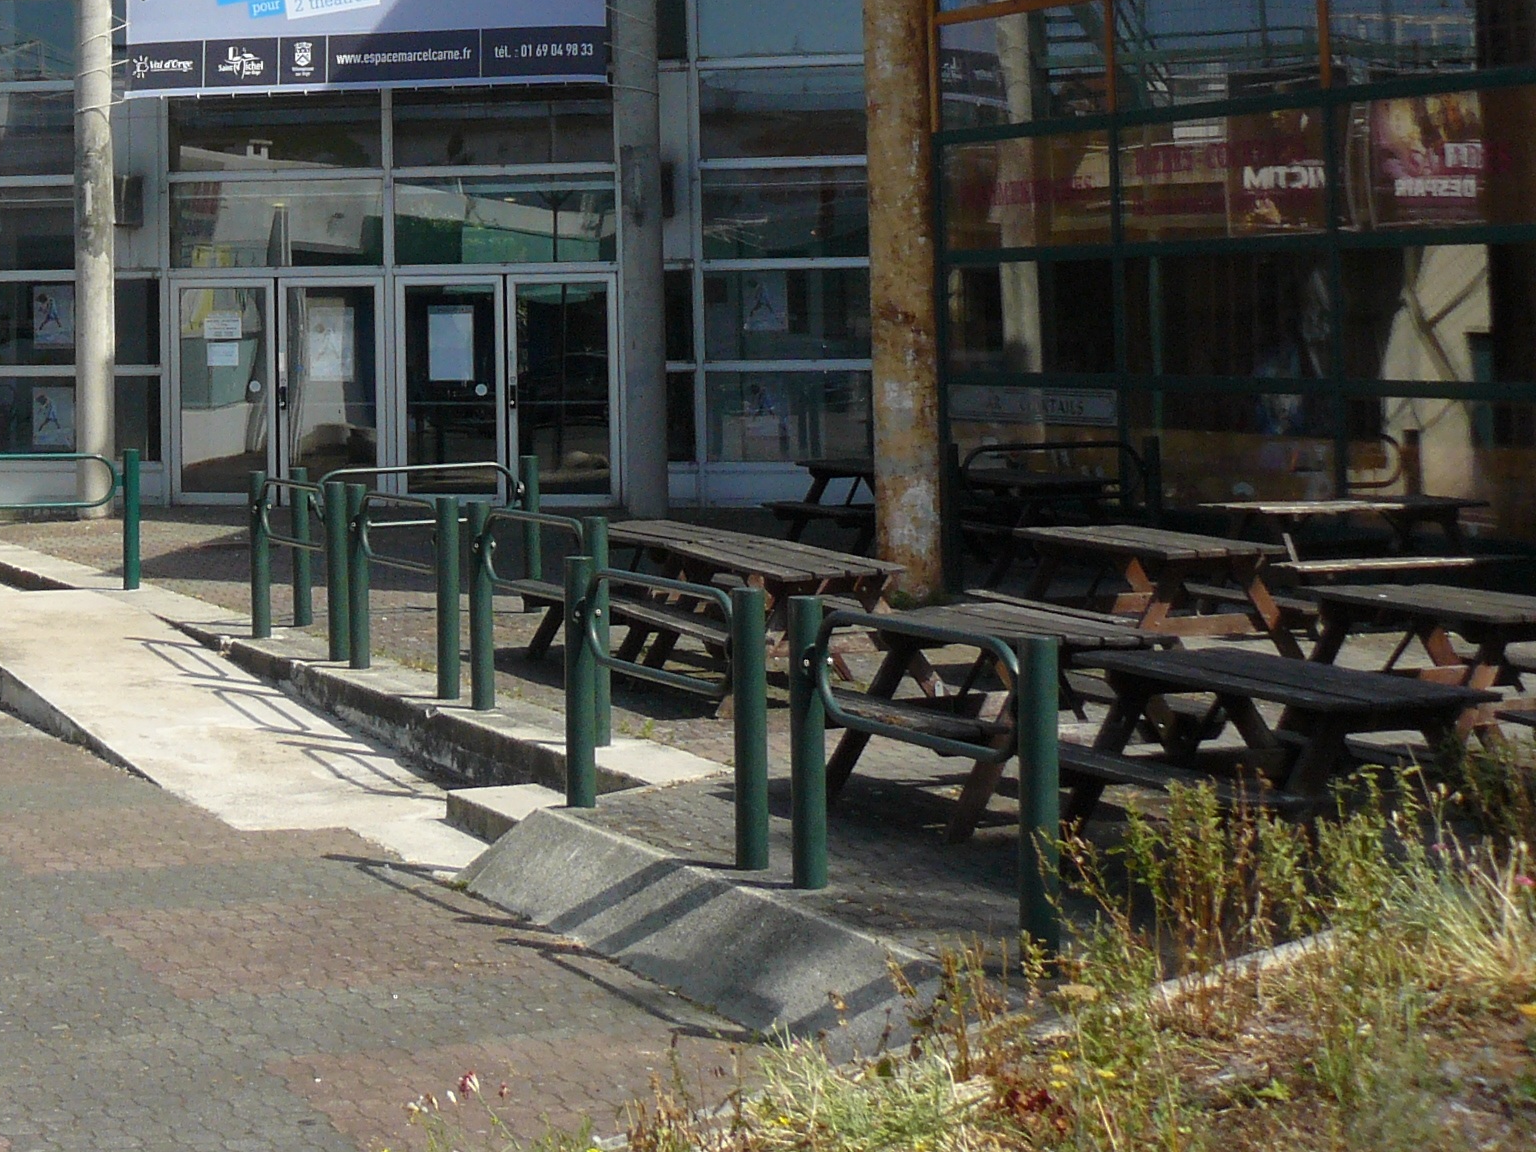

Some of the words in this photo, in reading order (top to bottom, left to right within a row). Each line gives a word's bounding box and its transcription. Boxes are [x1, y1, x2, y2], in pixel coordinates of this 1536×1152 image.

[252, 0, 281, 16] pour
[335, 47, 472, 66] www.espacemarcelcarne.fr
[493, 44, 512, 59] tél.
[520, 43, 533, 58] 01
[535, 43, 549, 57] 69
[550, 43, 564, 57] 04
[565, 42, 579, 56] 98
[580, 42, 594, 56] 33
